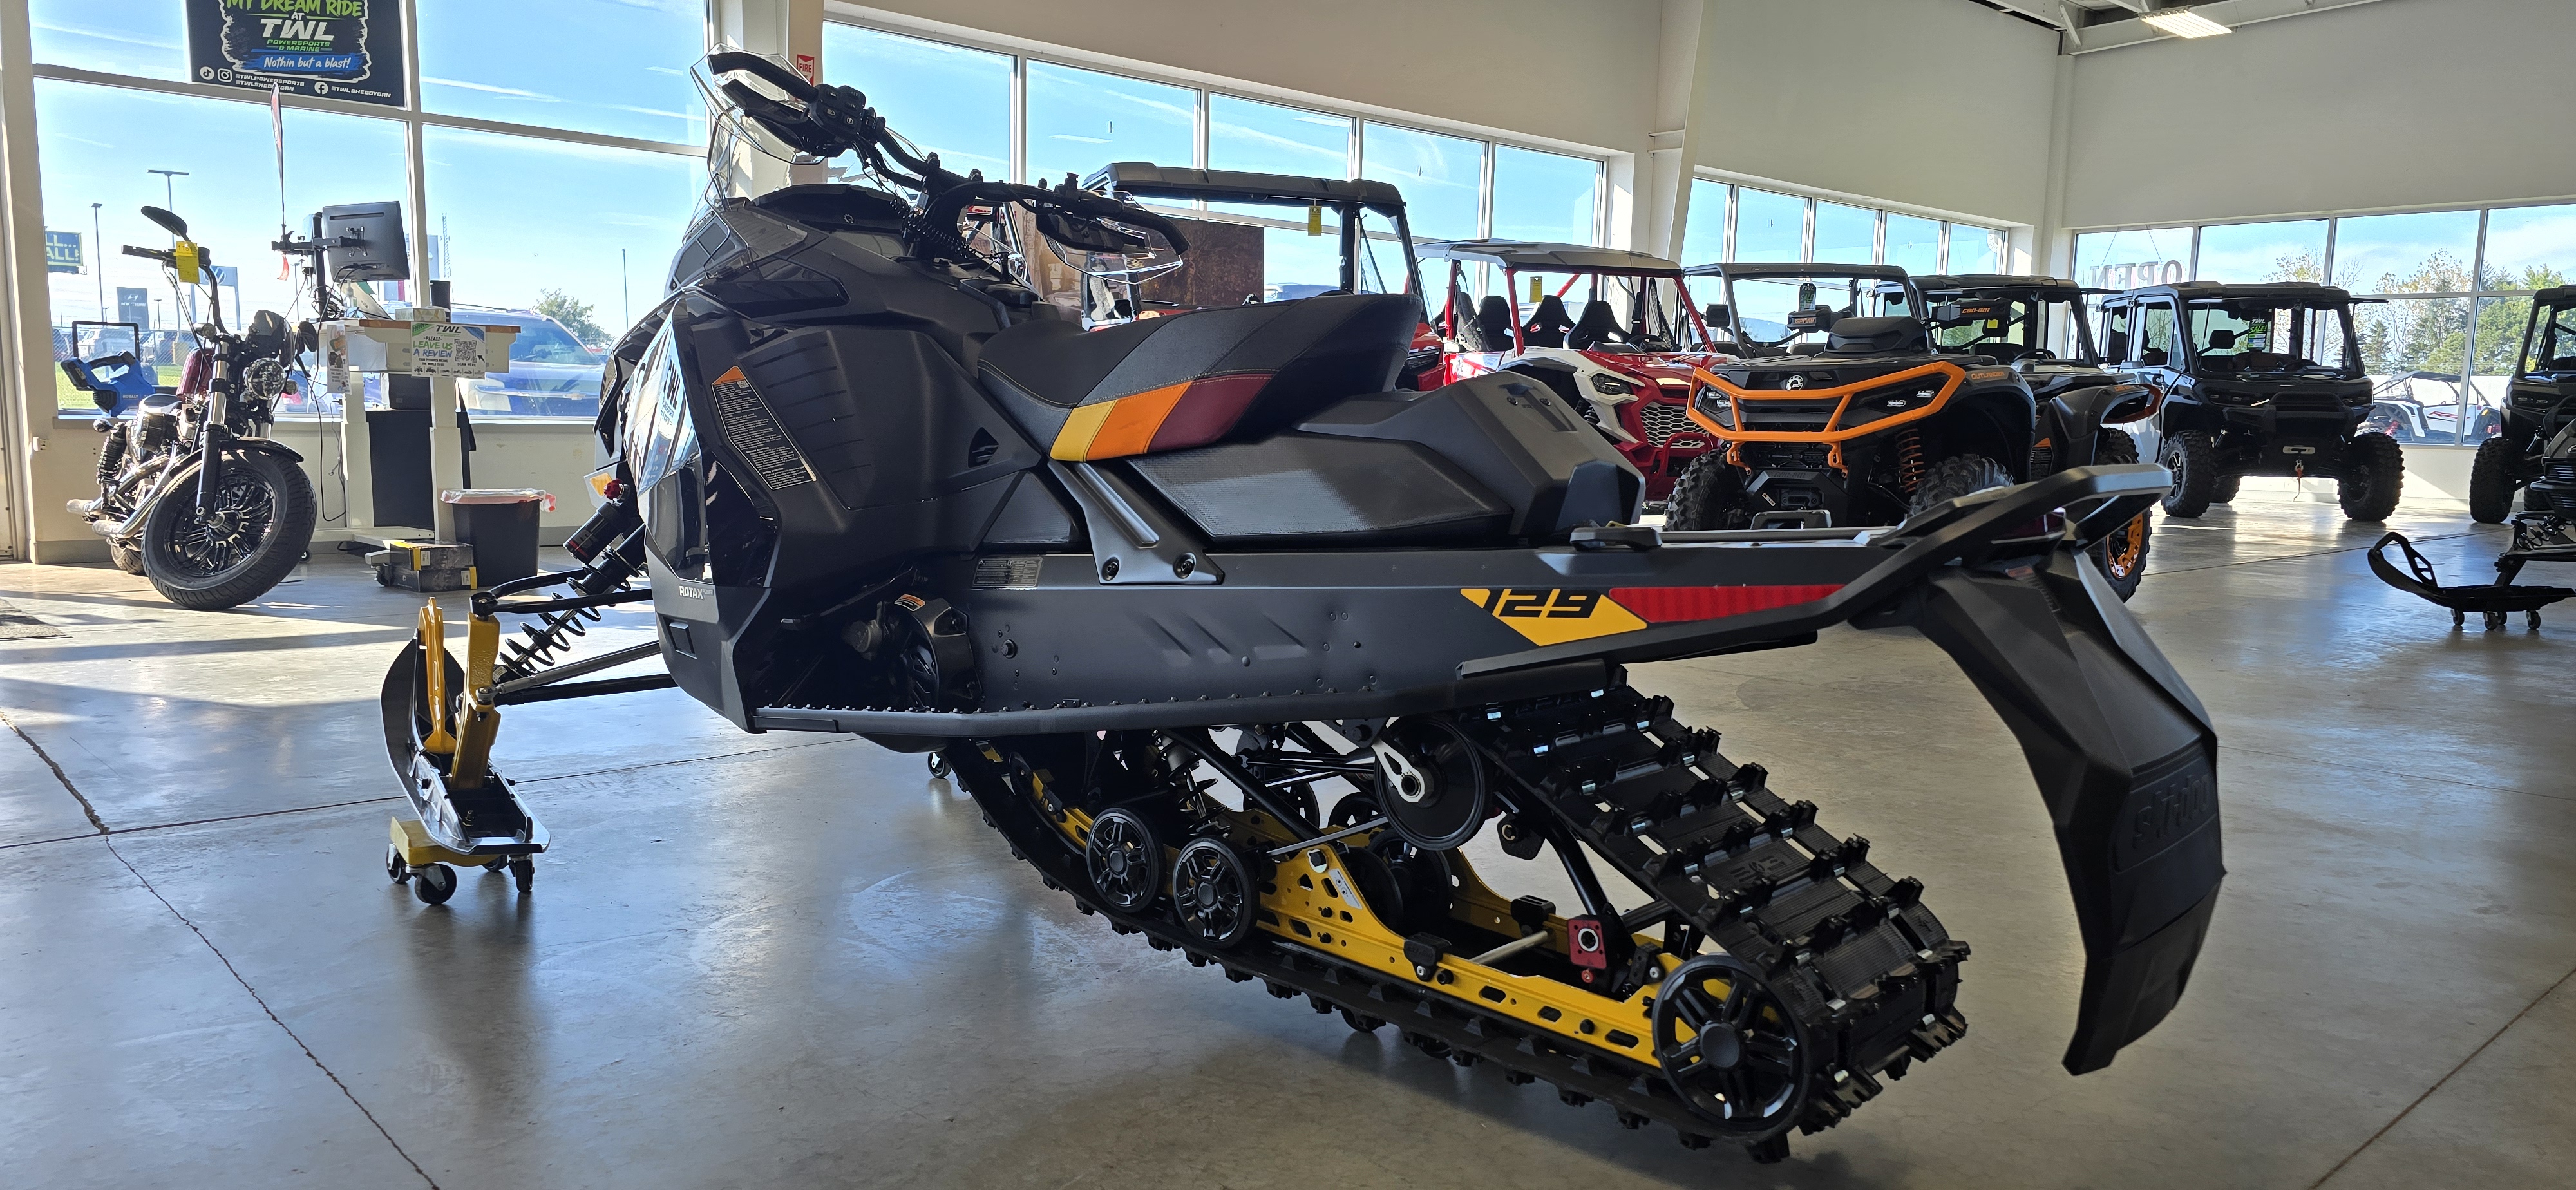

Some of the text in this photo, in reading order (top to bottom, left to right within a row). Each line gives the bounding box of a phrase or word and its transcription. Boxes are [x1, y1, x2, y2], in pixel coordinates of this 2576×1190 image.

[260, 0, 321, 14] DREAM
[326, 0, 363, 17] RIDE
[260, 19, 335, 41] TWL
[264, 56, 294, 68] Nothin
[298, 57, 314, 69] but
[324, 57, 352, 69] blast!
[799, 63, 811, 73] FIRE
[436, 325, 462, 334] TWL
[2249, 325, 2267, 334] SALE!
[413, 340, 453, 350] LEAVE US
[413, 348, 453, 358] A REVIEW
[1971, 372, 2005, 380] OUTLANDER
[679, 585, 704, 600] ROTAX
[1482, 589, 1603, 618] 129
